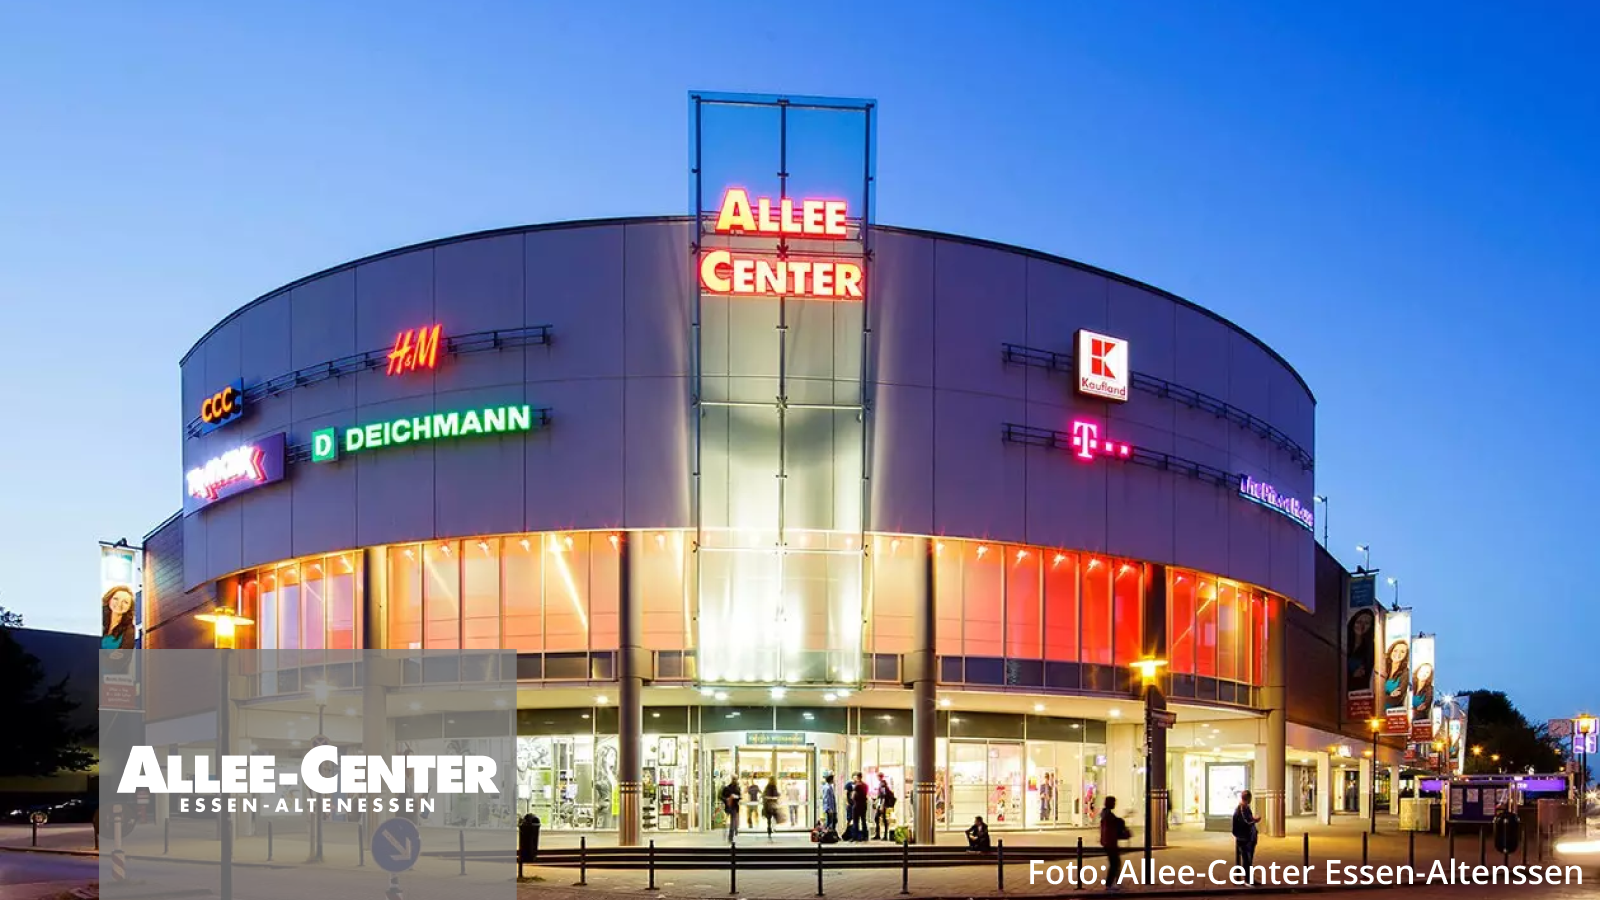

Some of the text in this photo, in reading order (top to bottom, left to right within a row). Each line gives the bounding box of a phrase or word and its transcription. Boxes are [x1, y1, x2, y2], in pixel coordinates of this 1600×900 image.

[715, 188, 847, 236] ALLEE
[700, 250, 862, 297] CENTER
[387, 324, 441, 375] H&M
[202, 386, 233, 423] CCC
[1082, 377, 1126, 396] Kaufland
[346, 405, 530, 451] DEICHMANN
